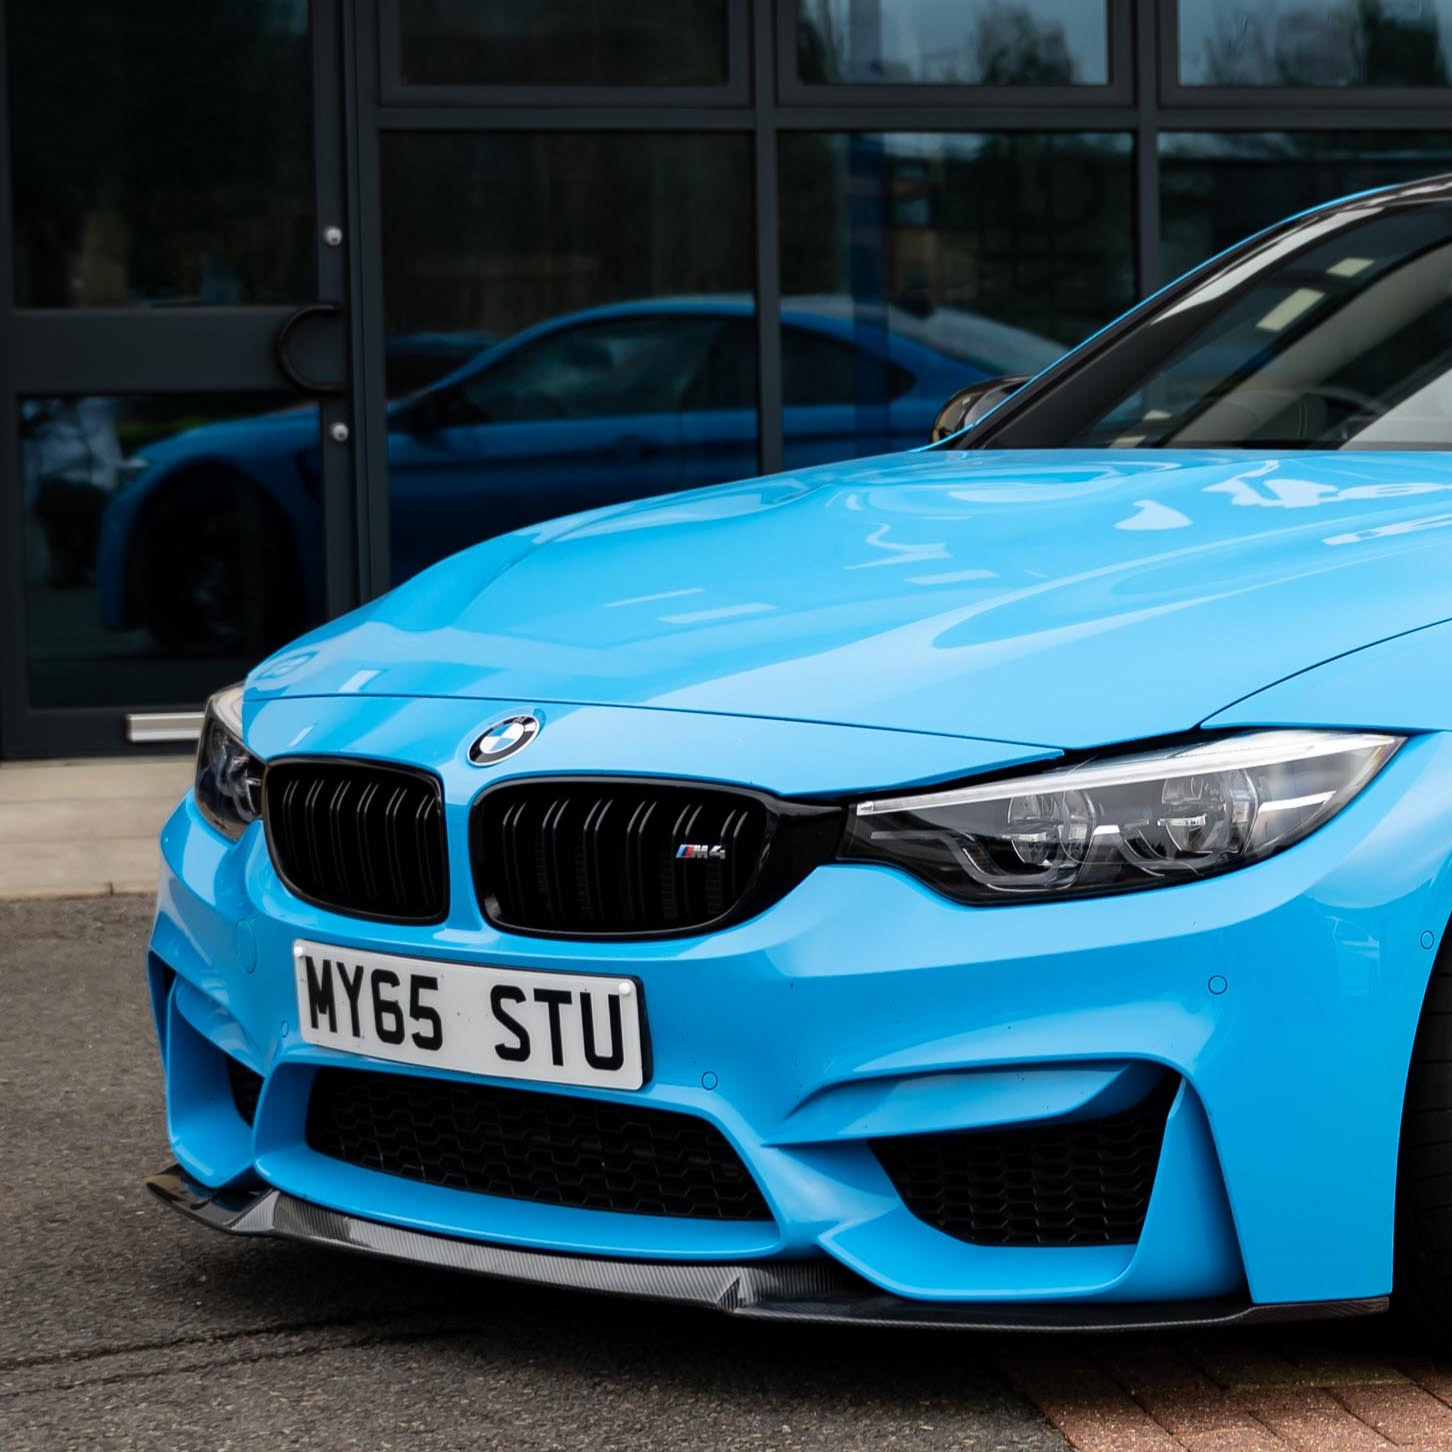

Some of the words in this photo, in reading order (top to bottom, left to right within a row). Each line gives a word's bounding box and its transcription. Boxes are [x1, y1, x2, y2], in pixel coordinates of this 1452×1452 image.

[687, 844, 727, 860] M4
[304, 955, 443, 1051] MY65
[490, 984, 625, 1071] STU
